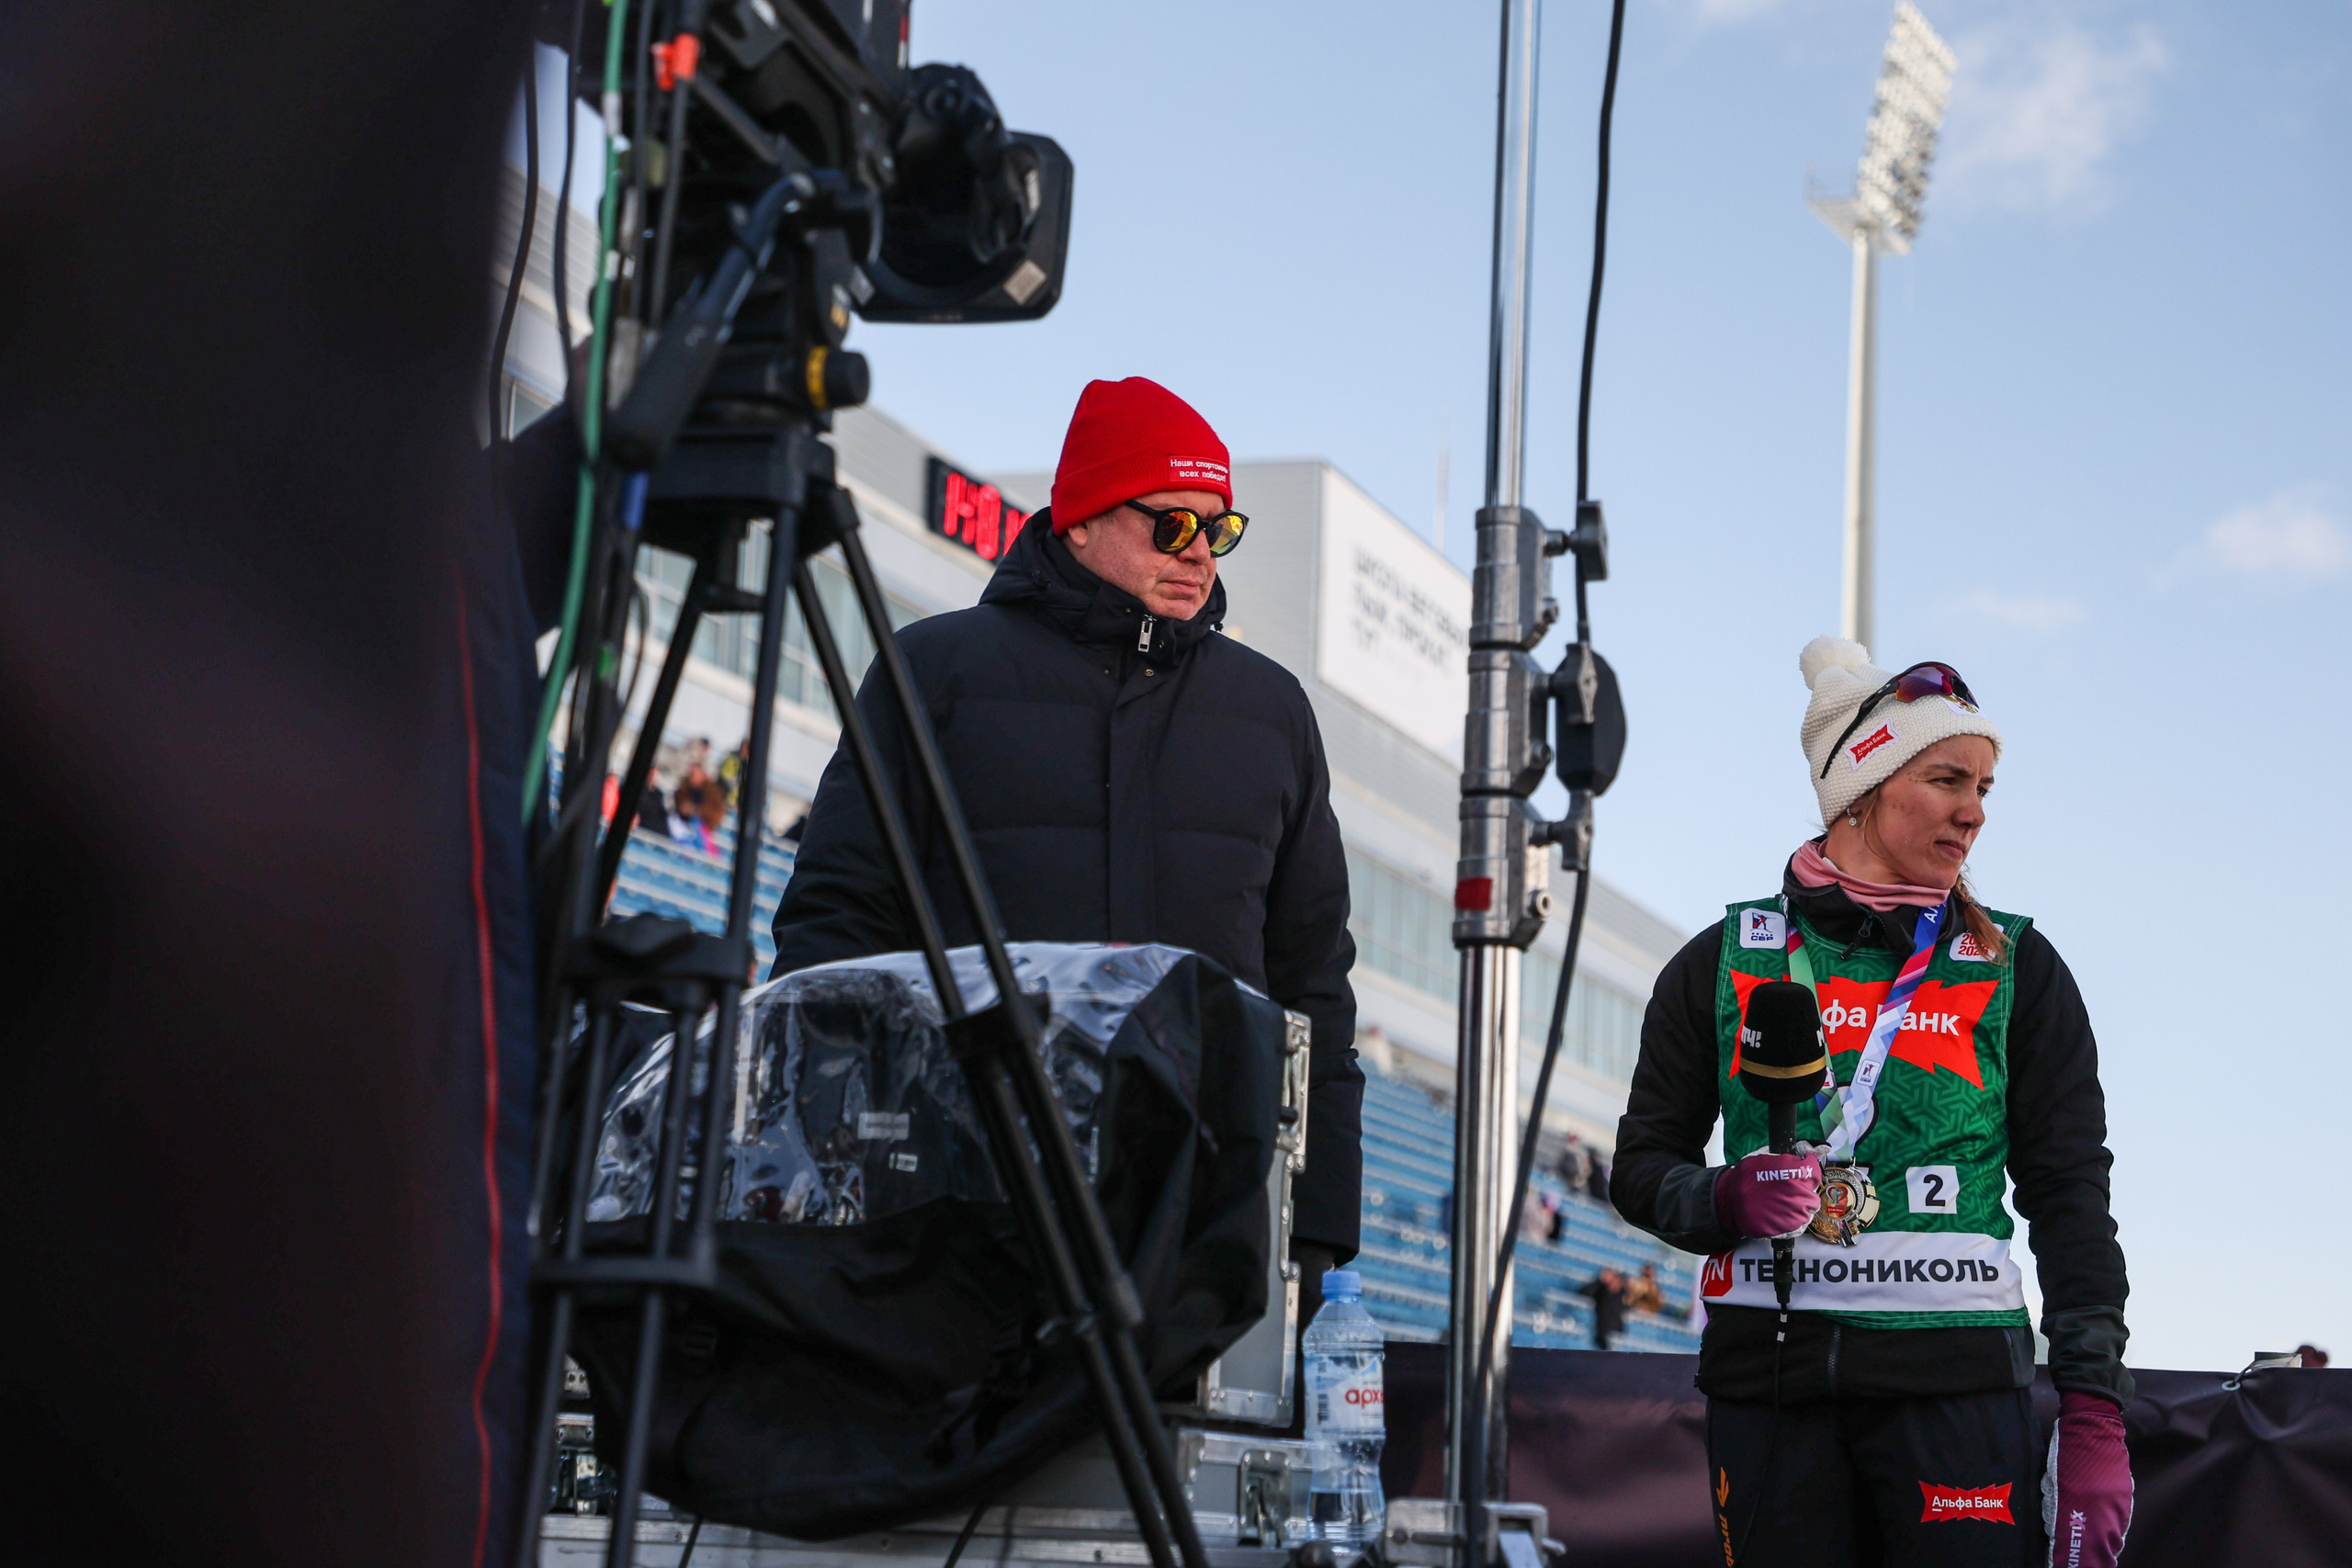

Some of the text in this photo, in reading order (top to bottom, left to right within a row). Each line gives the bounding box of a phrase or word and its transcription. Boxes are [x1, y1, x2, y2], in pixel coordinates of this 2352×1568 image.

[1876, 1003, 1962, 1037] анк
[1923, 1173, 1946, 1207] 2
[1739, 1258, 2000, 1284] ТЕНОНИКОЛЬ
[1931, 1495, 2004, 1512] Альфа Банк
